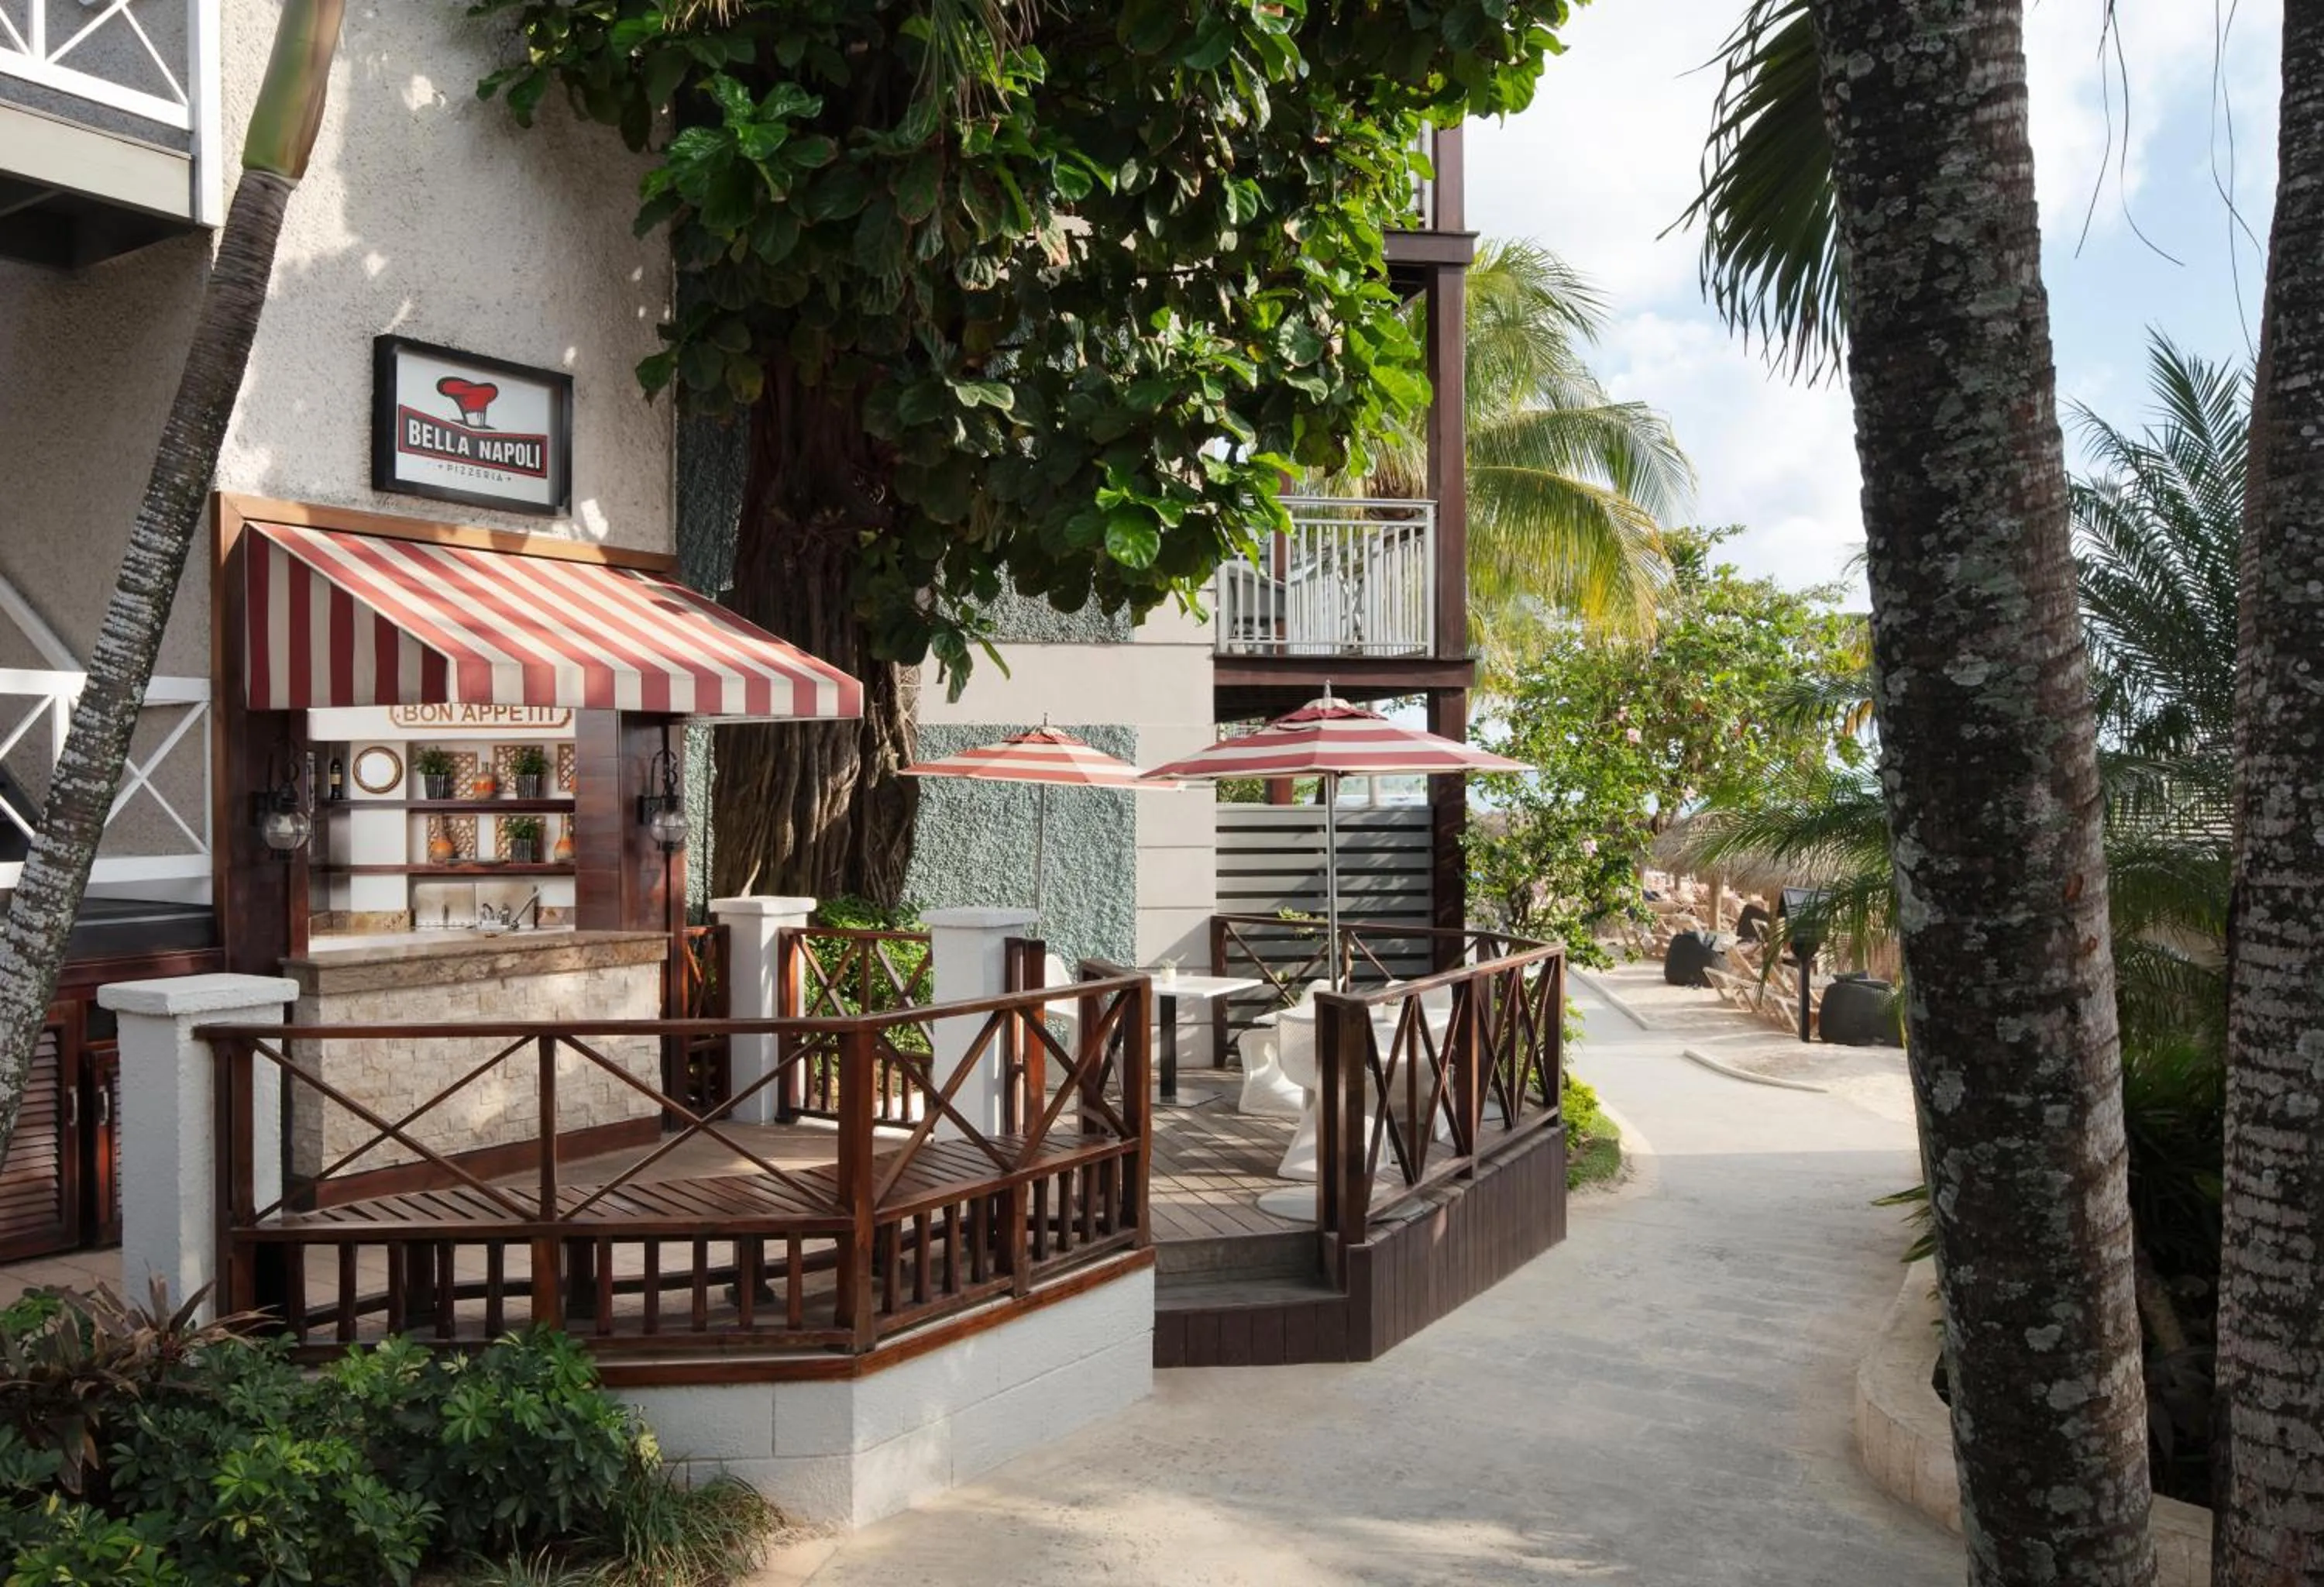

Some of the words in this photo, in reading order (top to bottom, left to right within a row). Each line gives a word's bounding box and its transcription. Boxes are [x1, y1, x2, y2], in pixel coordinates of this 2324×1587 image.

[407, 418, 469, 455] BELLA
[478, 440, 540, 469] NAPOLI
[447, 464, 504, 482] PIZZERIA
[403, 703, 453, 722] BON
